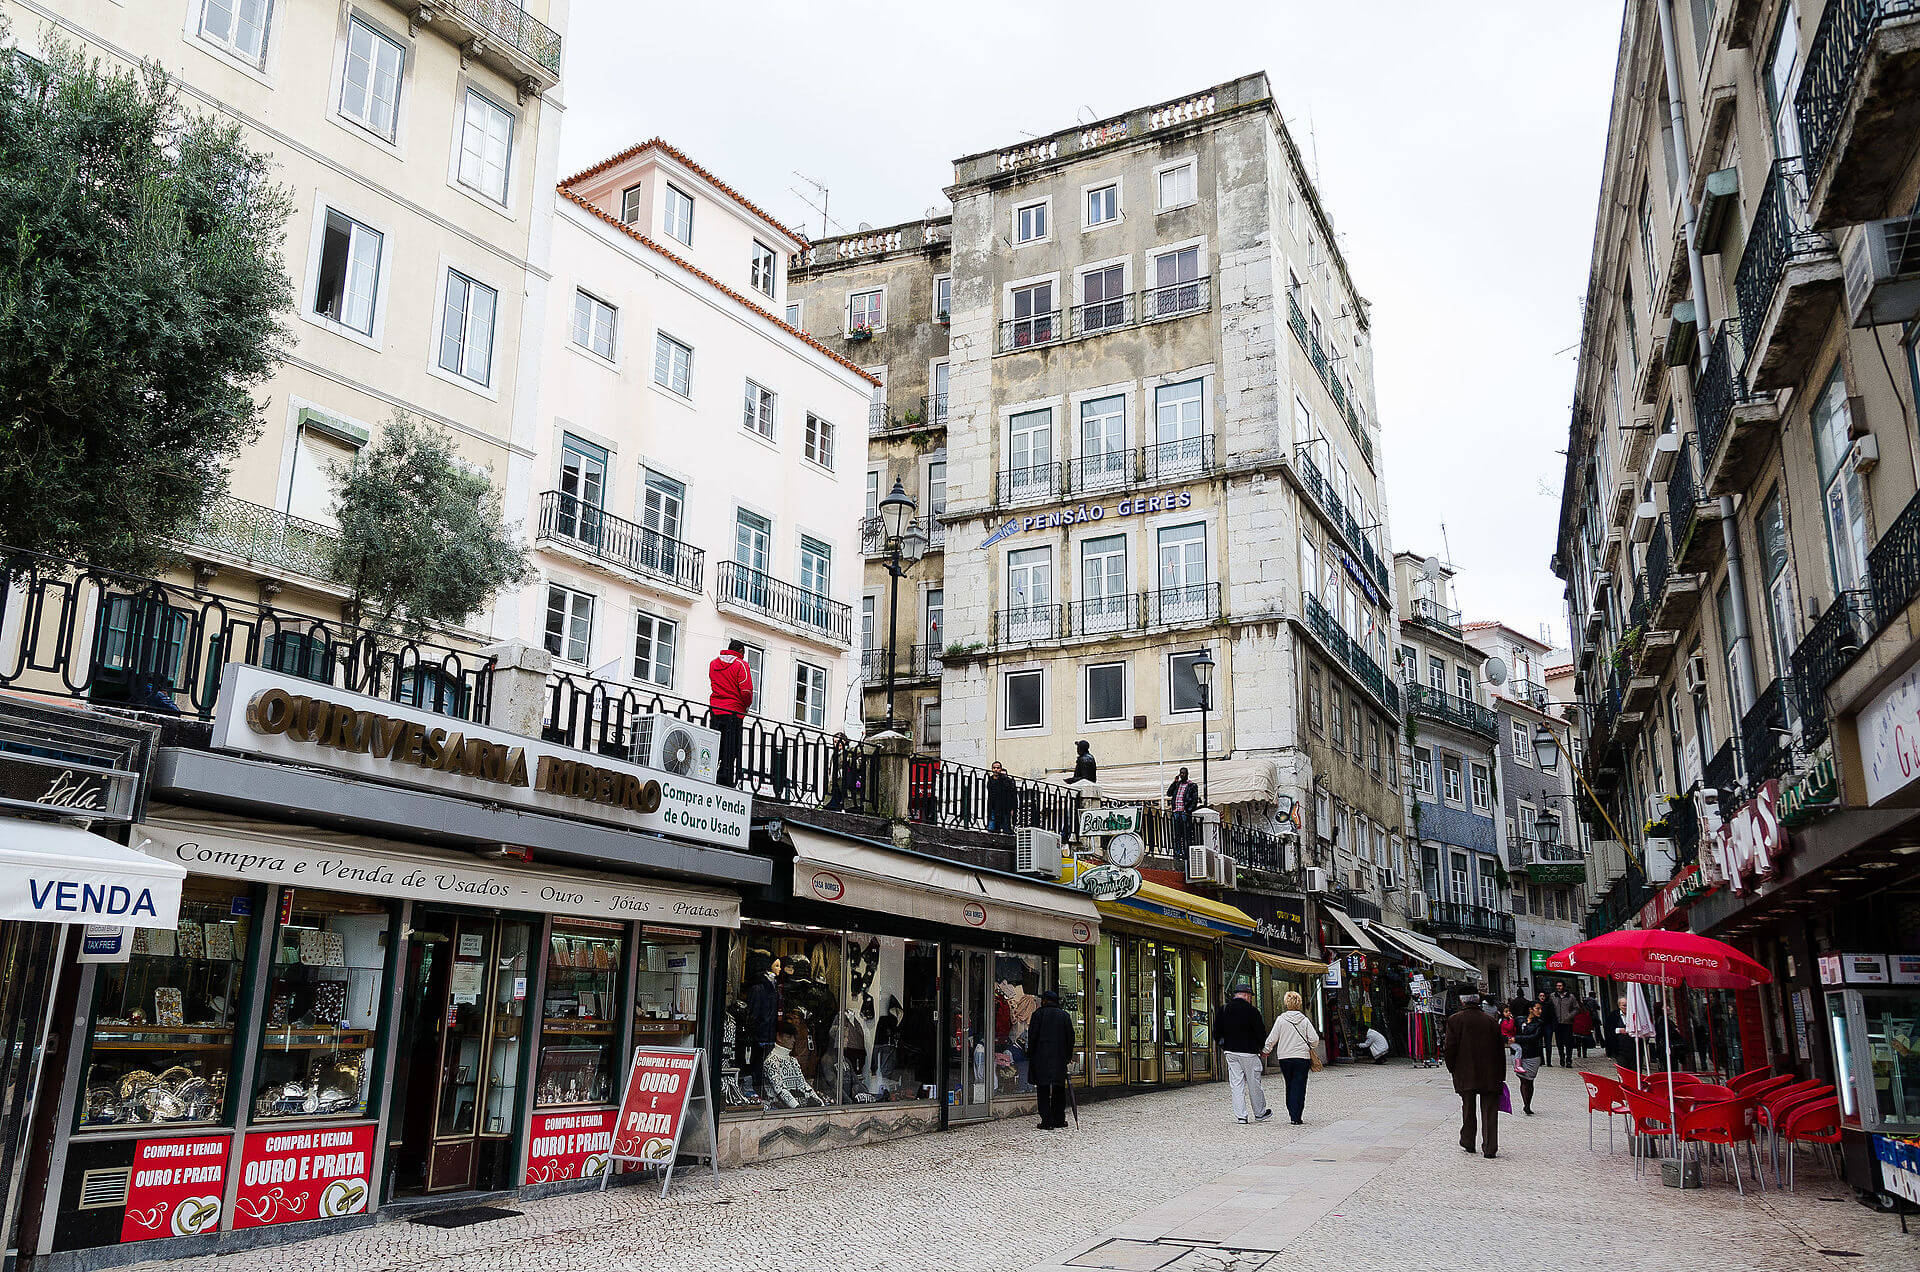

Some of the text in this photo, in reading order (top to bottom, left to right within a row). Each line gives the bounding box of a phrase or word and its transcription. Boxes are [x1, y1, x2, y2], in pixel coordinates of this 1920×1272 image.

[1023, 490, 1192, 531] PENSÃO GERÊS
[246, 688, 662, 814] OURIVESARIA RIBEIRO
[662, 782, 746, 817] Compra e Venda
[663, 807, 741, 837] de Ouro Usado
[175, 841, 285, 873] Compra
[293, 861, 307, 873] e
[317, 859, 395, 886] Venda
[401, 868, 426, 888] de
[435, 874, 511, 898] Usados
[540, 886, 584, 905] Ouro
[609, 894, 650, 912] Jóias
[672, 901, 720, 918] Pratas
[29, 878, 157, 918] VENDA
[88, 940, 117, 949] TAX FREE
[1648, 950, 1719, 968] intensamente
[636, 1056, 693, 1069] COMPRA E VENDA
[639, 1072, 680, 1094] OURO
[651, 1096, 658, 1109] E
[544, 1114, 603, 1131] COMPRA E VENDA
[626, 1113, 672, 1135] PRATA
[143, 1142, 223, 1159] COMPRA E VENDA
[265, 1131, 353, 1153] COMPRA E VENDA
[532, 1130, 611, 1158] OURO E PRATA
[135, 1165, 222, 1188] OURO E PRATA
[244, 1151, 365, 1187] OURO E PRATA
